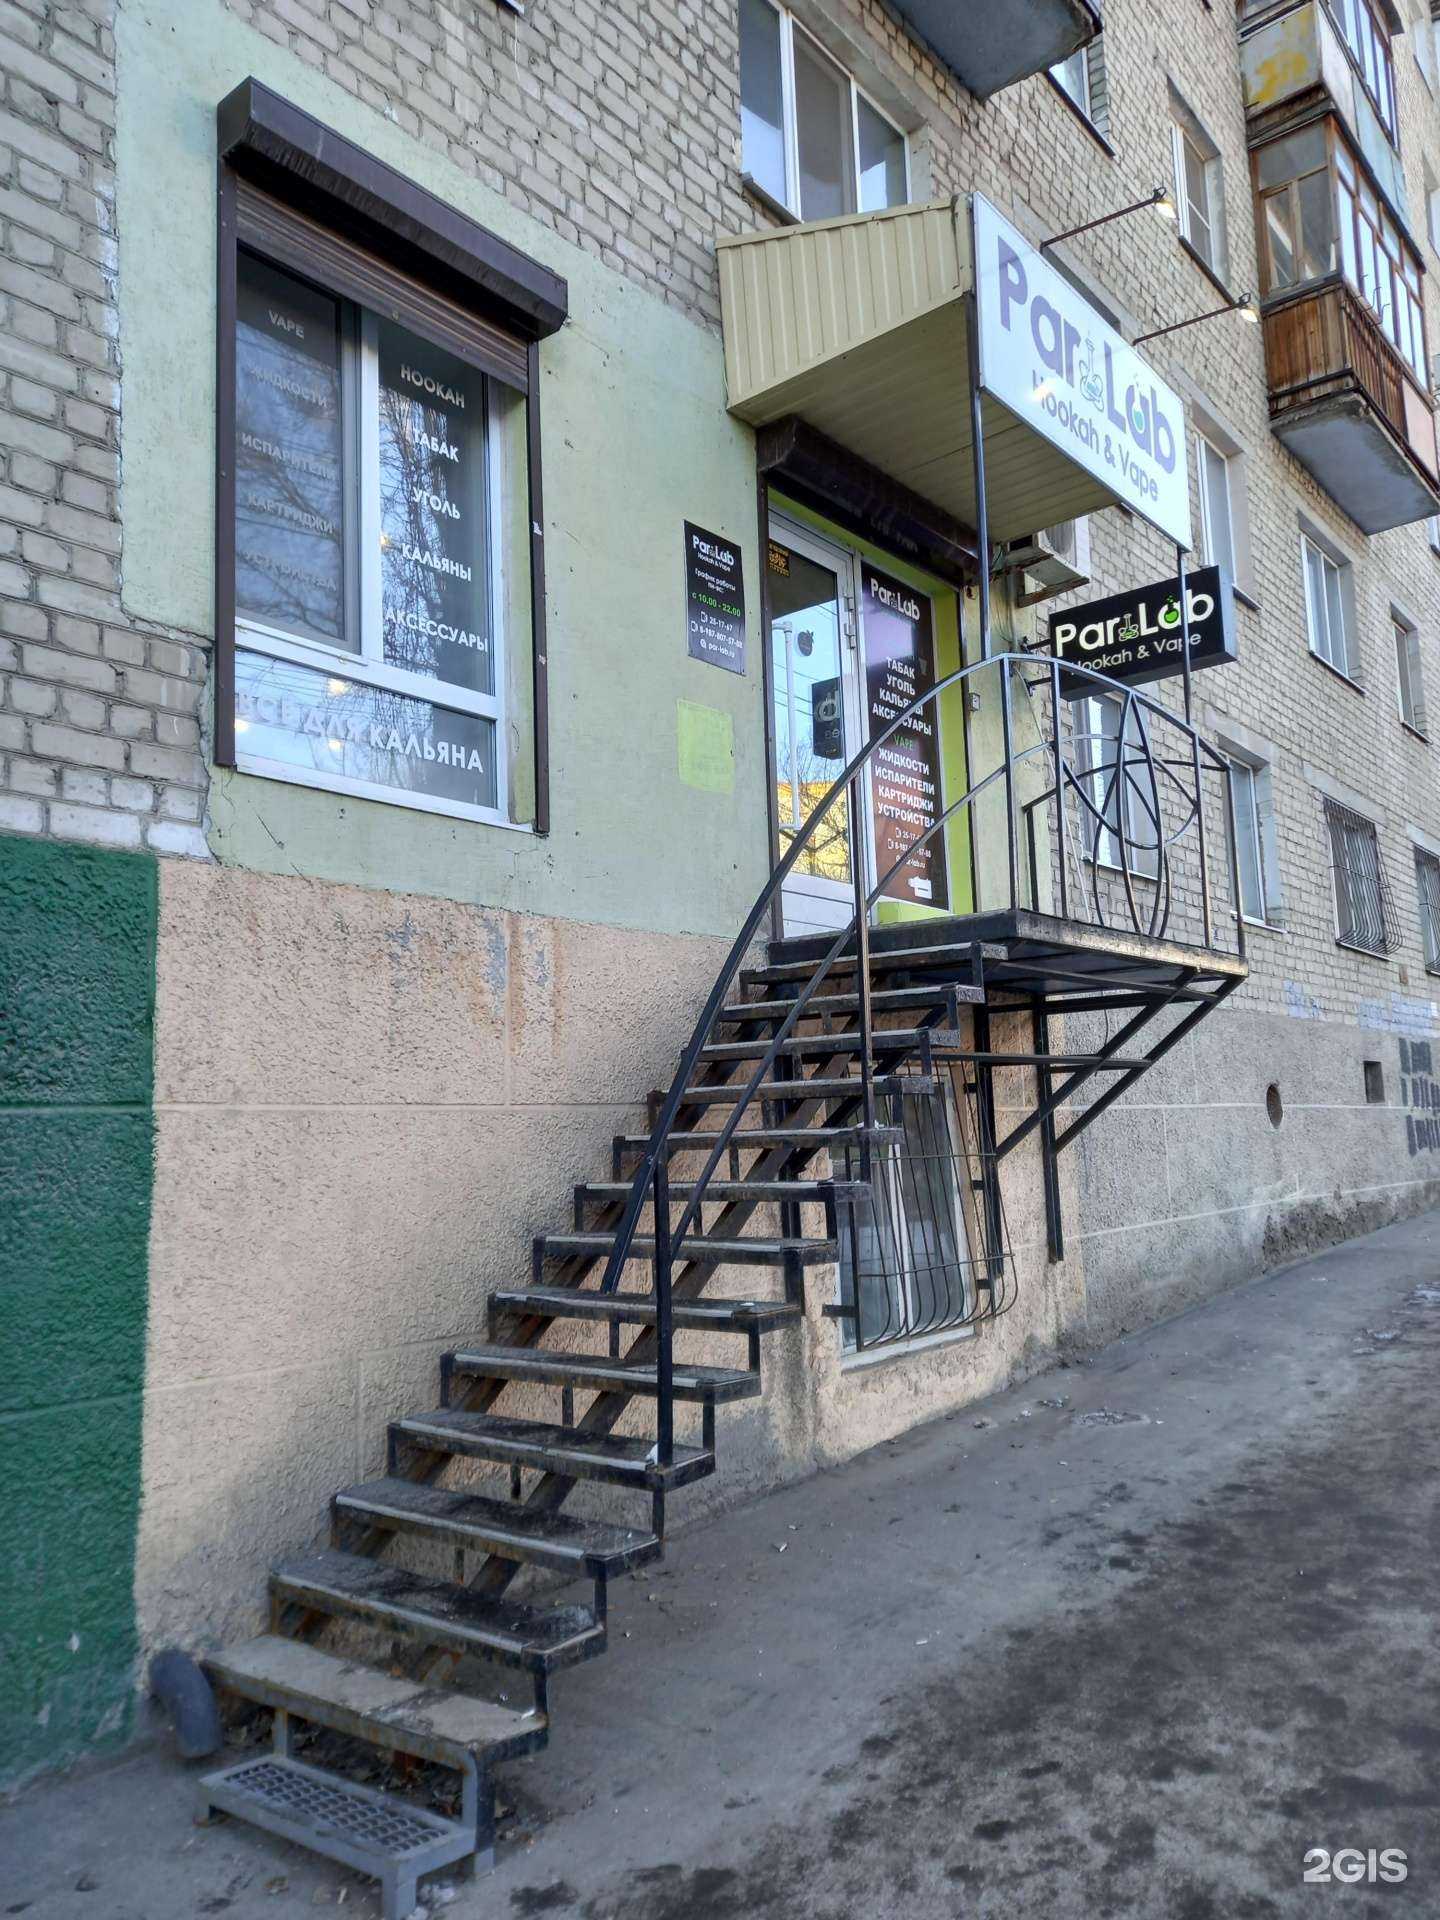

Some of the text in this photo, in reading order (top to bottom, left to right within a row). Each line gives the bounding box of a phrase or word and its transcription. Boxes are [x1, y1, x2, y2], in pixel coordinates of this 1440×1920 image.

[268, 310, 305, 339] VAPE
[249, 367, 329, 408] ЖИДКОСТИ
[400, 364, 465, 408] HOOKAH
[240, 432, 337, 481] ИСПАРИТЕЛИ
[413, 428, 459, 463] ТАБАК
[1103, 437, 1116, 468] &
[1118, 445, 1158, 502] Vape
[412, 486, 461, 520] УГОЛЬ
[401, 543, 472, 582] КАЛЬЯНЫ
[698, 594, 717, 608] 10.00
[722, 603, 741, 617] 22.00
[383, 608, 489, 652] АКСЕССУАРЫ
[1137, 645, 1151, 659] &
[1153, 633, 1202, 655] Vae
[886, 655, 915, 680] ТАБАК
[886, 673, 916, 696] УГОЛЬ
[879, 687, 924, 717] КАЛЬЯЫ
[872, 702, 932, 736] АКСЕСУАРЫ
[303, 704, 366, 743] ДЛЯ
[368, 724, 484, 774] КАЛЬЯНА
[893, 734, 914, 750] VAPE
[878, 747, 930, 776] ЖИДКОСТИ
[874, 765, 935, 796] ИСПАРИТЕЛИ
[878, 785, 934, 813] КАРТРИДЖИ
